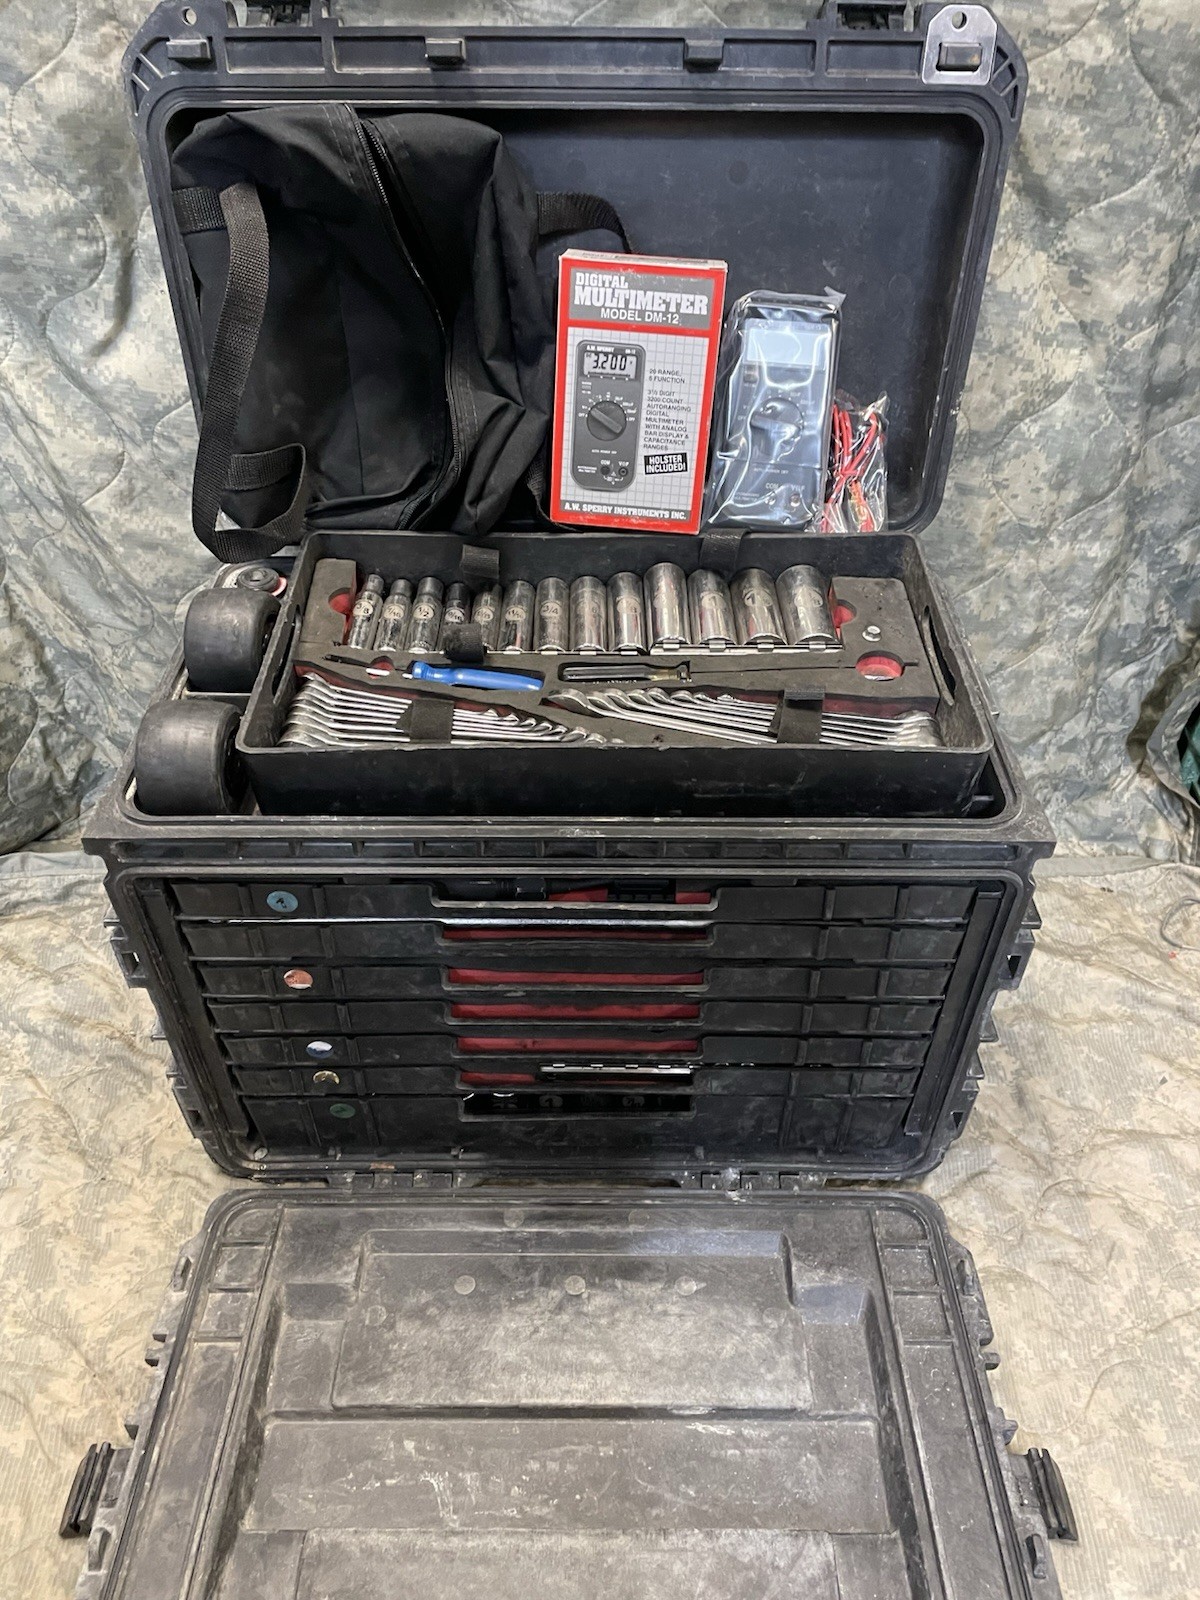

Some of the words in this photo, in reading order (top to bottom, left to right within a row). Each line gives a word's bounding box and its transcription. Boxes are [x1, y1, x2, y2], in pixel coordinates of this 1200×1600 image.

[575, 272, 629, 289] DIGITAL
[574, 285, 709, 315] MULTIMETER
[600, 307, 642, 321] MODEL
[644, 311, 680, 325] DM-12
[653, 376, 685, 384] FUNCTION
[647, 403, 691, 412] AUTORANGING
[645, 409, 670, 418] DIGITAL
[645, 416, 684, 426] MULTIMETER
[660, 424, 688, 433] ANALOG
[658, 431, 684, 439] DISPLAY
[643, 436, 686, 446] CAPACITANCE
[643, 443, 669, 451] RANGES
[649, 455, 682, 465] HOLSTER
[645, 462, 686, 473] INCLUDED!
[564, 502, 581, 511] A.W.
[582, 503, 614, 514] SPERRY
[613, 506, 670, 519] INSTRUMENTS
[670, 511, 687, 520] INC.
